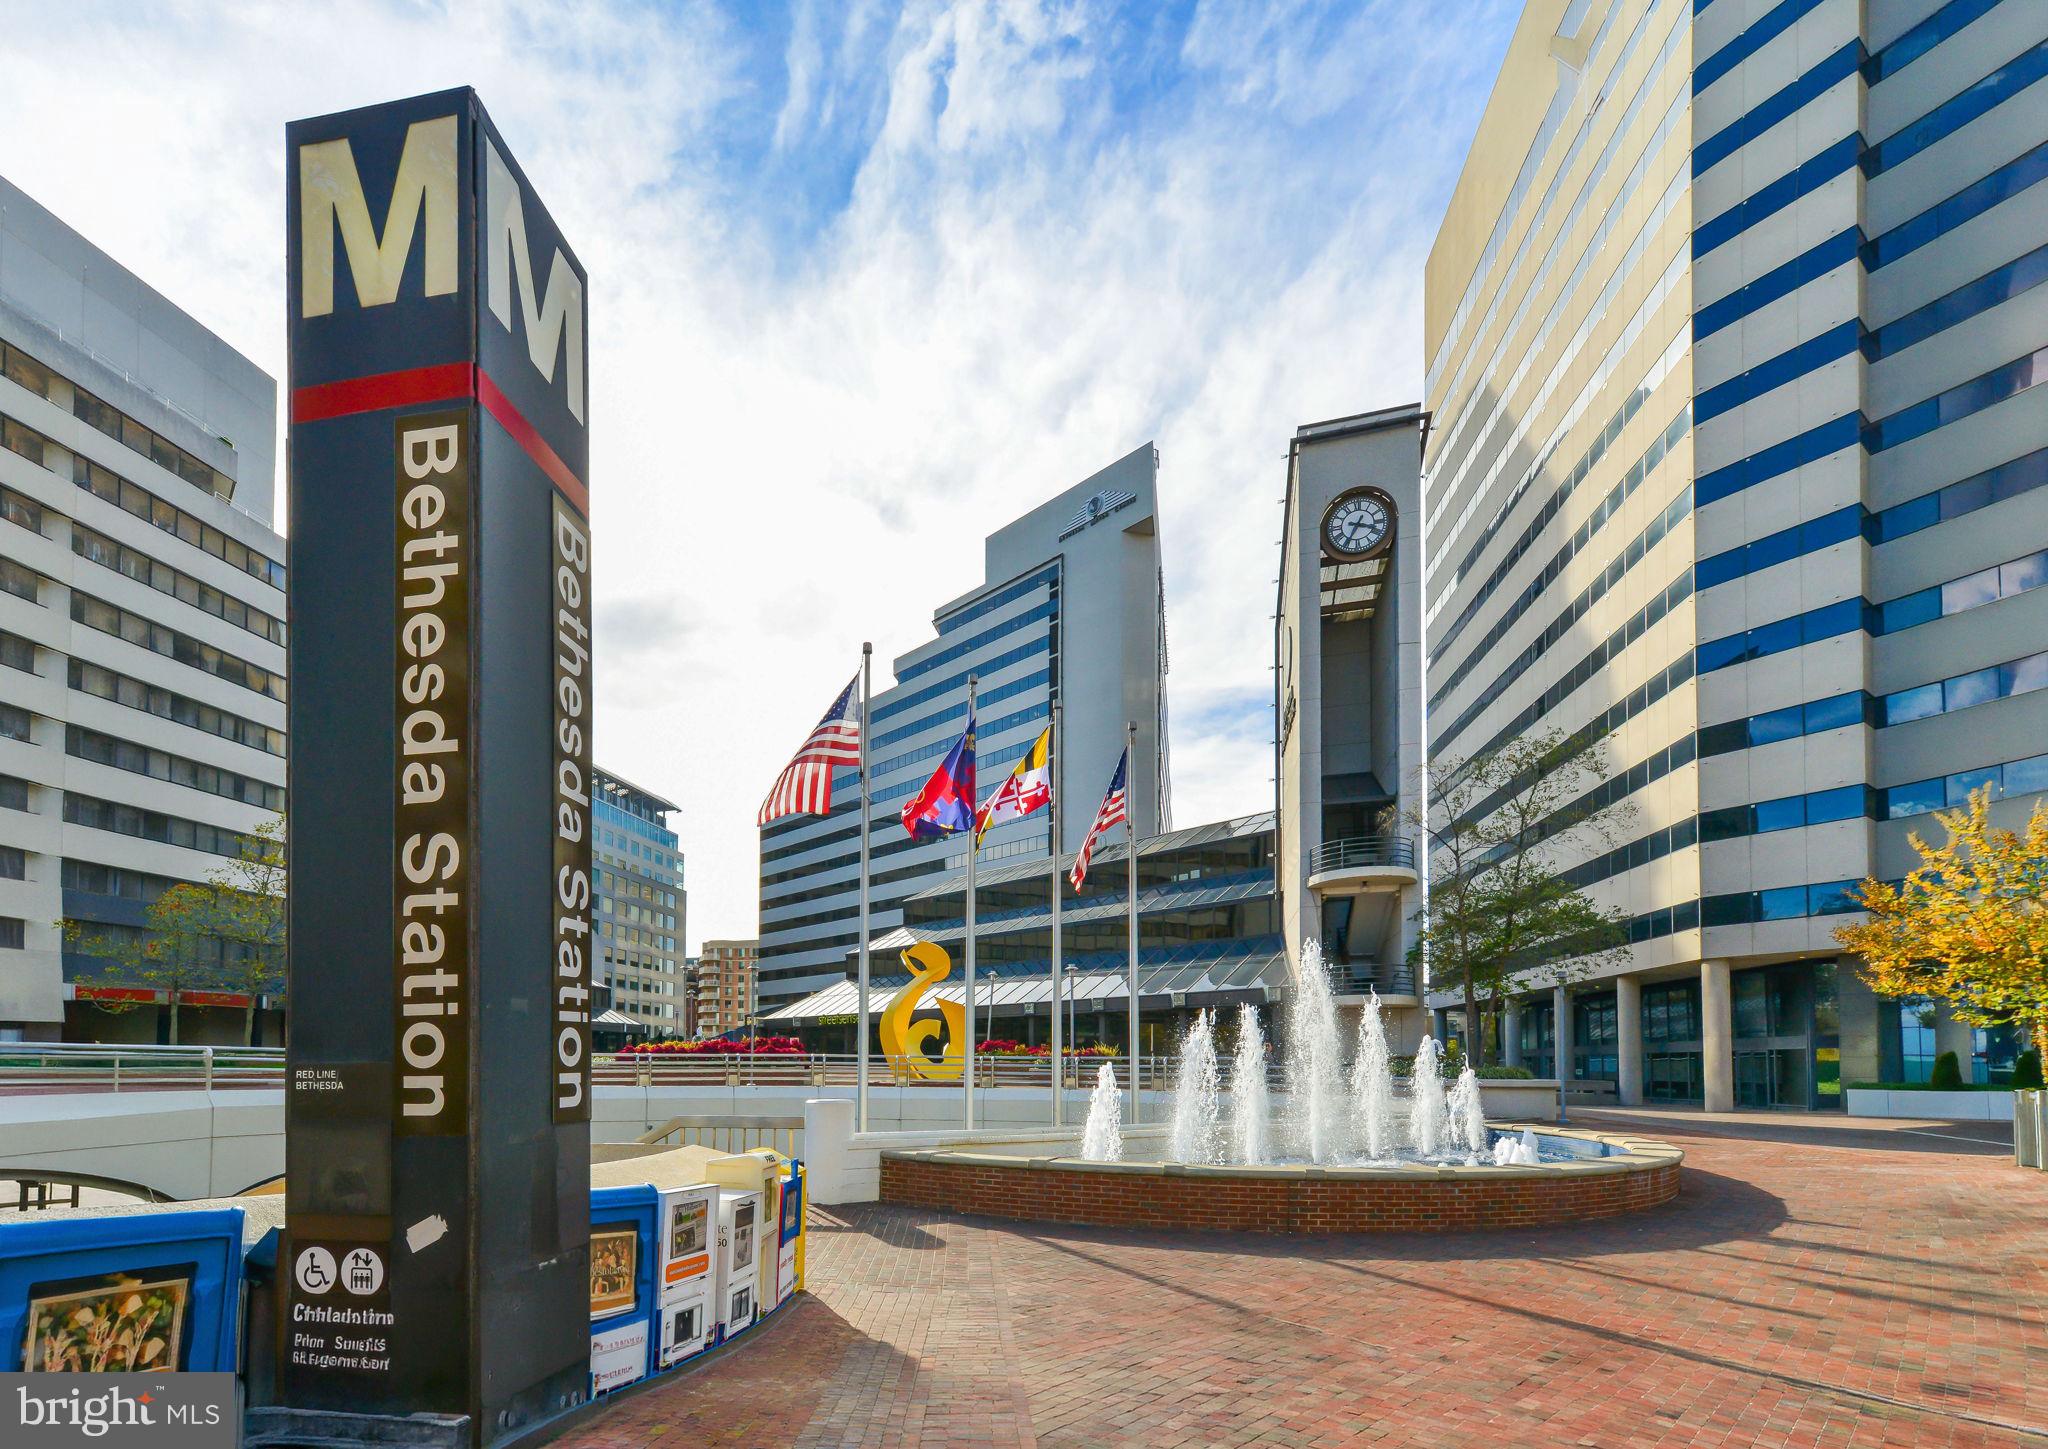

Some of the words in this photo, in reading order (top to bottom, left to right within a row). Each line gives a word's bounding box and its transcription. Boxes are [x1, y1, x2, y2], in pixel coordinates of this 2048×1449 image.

[299, 114, 458, 319] M
[486, 134, 583, 428] M
[402, 424, 459, 806] Bethesda
[557, 511, 589, 843] Bethesda
[296, 1070, 314, 1079] RED
[316, 1070, 337, 1079] LINE
[296, 1081, 344, 1090] BETHESDA
[402, 832, 460, 1117] Station
[558, 864, 589, 1108] Station
